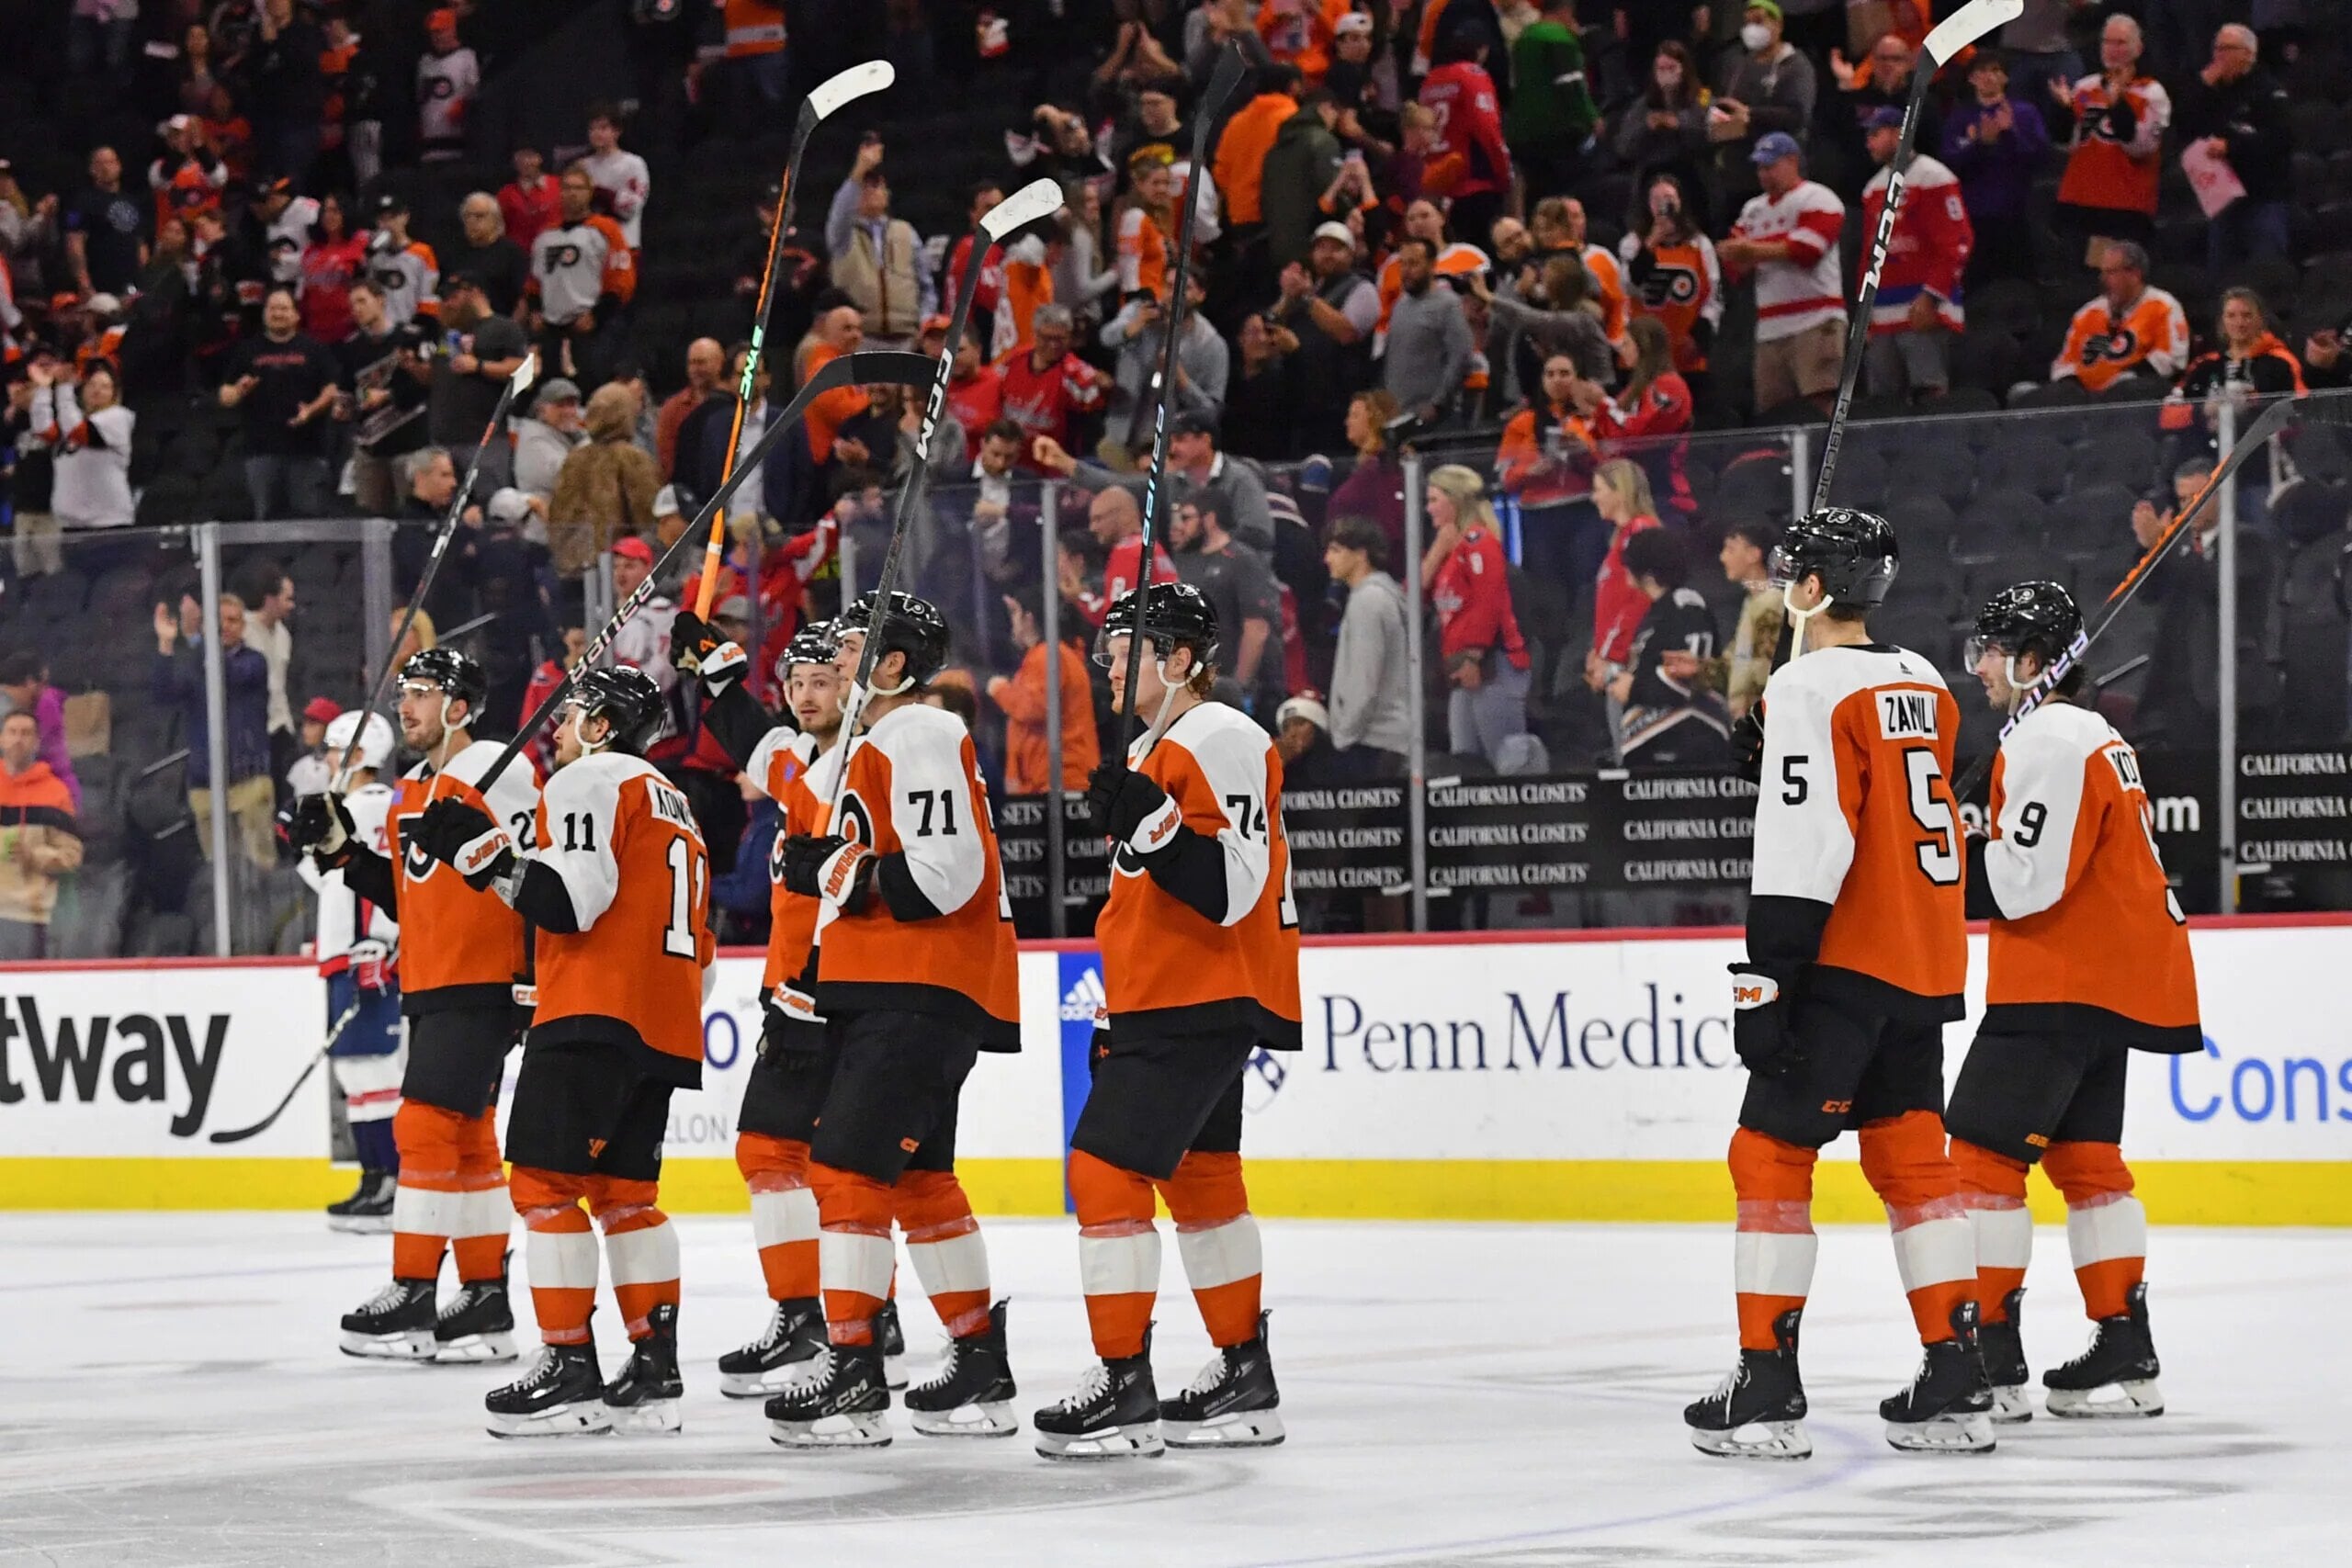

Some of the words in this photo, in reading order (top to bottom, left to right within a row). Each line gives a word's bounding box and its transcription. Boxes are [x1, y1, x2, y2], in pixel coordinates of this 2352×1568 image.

[1859, 171, 1905, 302] CCM
[739, 325, 763, 400] SYNC
[916, 347, 953, 460] CCM
[1818, 399, 1849, 498] RIBCOR
[570, 574, 656, 684] BAUER
[2241, 753, 2346, 776] CALIFORNIA
[1623, 778, 1716, 800] CALIFORNIA
[1782, 755, 1808, 806] 5
[1337, 787, 1403, 808] CLOSETS
[1428, 785, 1519, 807] CALIFORNIA
[1521, 783, 1589, 804] CLOSETS
[2241, 796, 2346, 819] CALIFORNIA
[909, 790, 957, 837] 71
[1001, 801, 1045, 826] SETS
[1902, 746, 1961, 886] 5
[2014, 802, 2047, 847] 9
[564, 812, 596, 852] 11
[1338, 828, 1403, 848] CLOSETS
[1429, 825, 1519, 847] CALIFORNIA
[1521, 823, 1589, 844] CLOSETS
[1624, 819, 1717, 840] CALIFORNIA
[1001, 838, 1046, 863] SETS
[2241, 840, 2346, 863] CALIFORNIA
[1339, 866, 1404, 887] CLOSETS
[1430, 865, 1520, 886] CALIFORNIA
[1521, 863, 1590, 885] CLOSETS
[1624, 860, 1718, 881] CALIFORNIA
[1319, 995, 1490, 1072] Penn
[1505, 982, 1743, 1070] Medic
